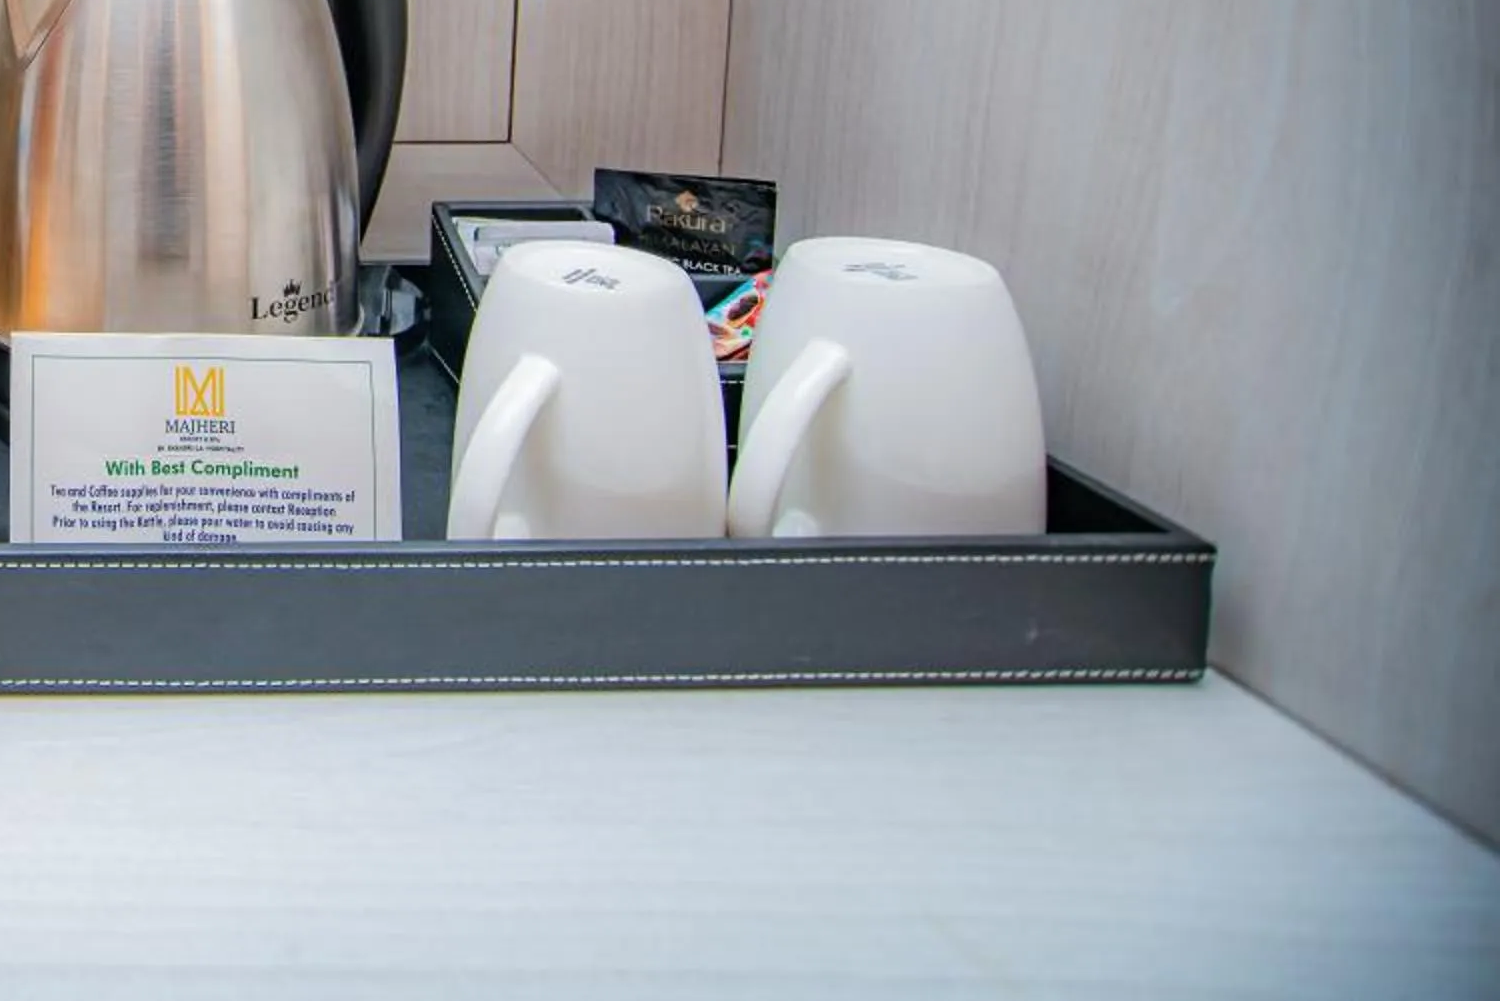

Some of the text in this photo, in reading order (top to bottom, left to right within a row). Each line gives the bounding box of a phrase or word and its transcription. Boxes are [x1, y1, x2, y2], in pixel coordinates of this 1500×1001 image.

[647, 205, 725, 234] Rakura
[683, 259, 719, 273] BLACK
[723, 265, 741, 275] TEA
[165, 419, 236, 434] MAJHERI
[105, 460, 299, 479] With Best Compliment
[68, 484, 86, 497] and
[88, 485, 118, 498] Coffee
[120, 485, 158, 498] supplies
[160, 484, 173, 496] for
[258, 488, 279, 498] with
[345, 491, 355, 502] of
[127, 501, 143, 512] For
[53, 516, 76, 528] Prior
[79, 517, 88, 528] to
[186, 530, 195, 542] of
